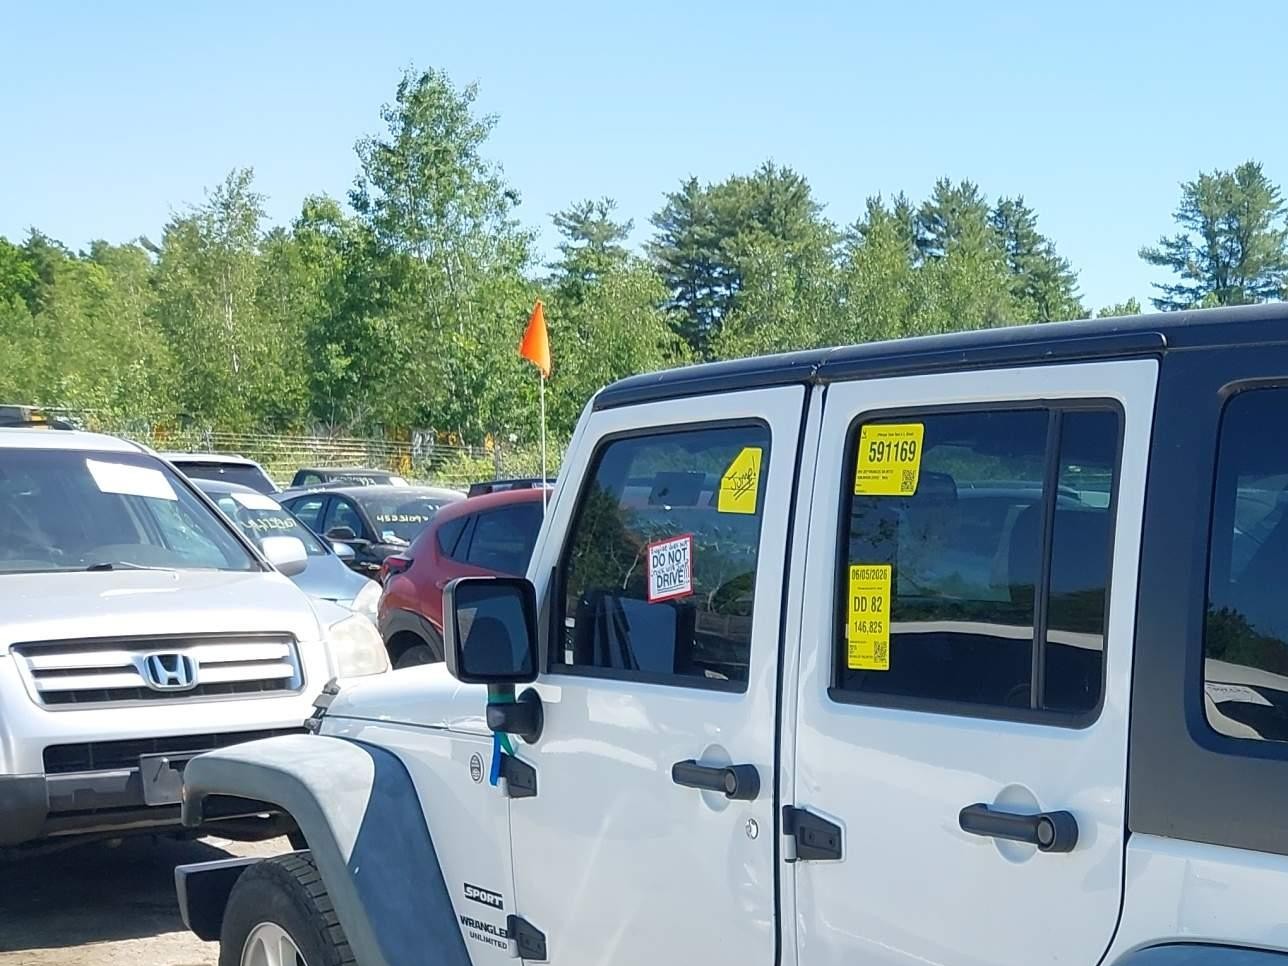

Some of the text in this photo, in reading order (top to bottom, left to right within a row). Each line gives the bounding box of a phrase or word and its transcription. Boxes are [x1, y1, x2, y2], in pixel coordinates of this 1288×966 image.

[868, 440, 917, 463] 591169
[652, 553, 666, 569] DO
[668, 547, 687, 565] NOT
[851, 568, 888, 581] 06/05/2026
[853, 596, 883, 613] DD 82
[854, 620, 883, 634] 146,825
[464, 886, 503, 906] SPORT
[460, 915, 508, 939] WRANGLE
[469, 931, 508, 950] UNLIMITED
